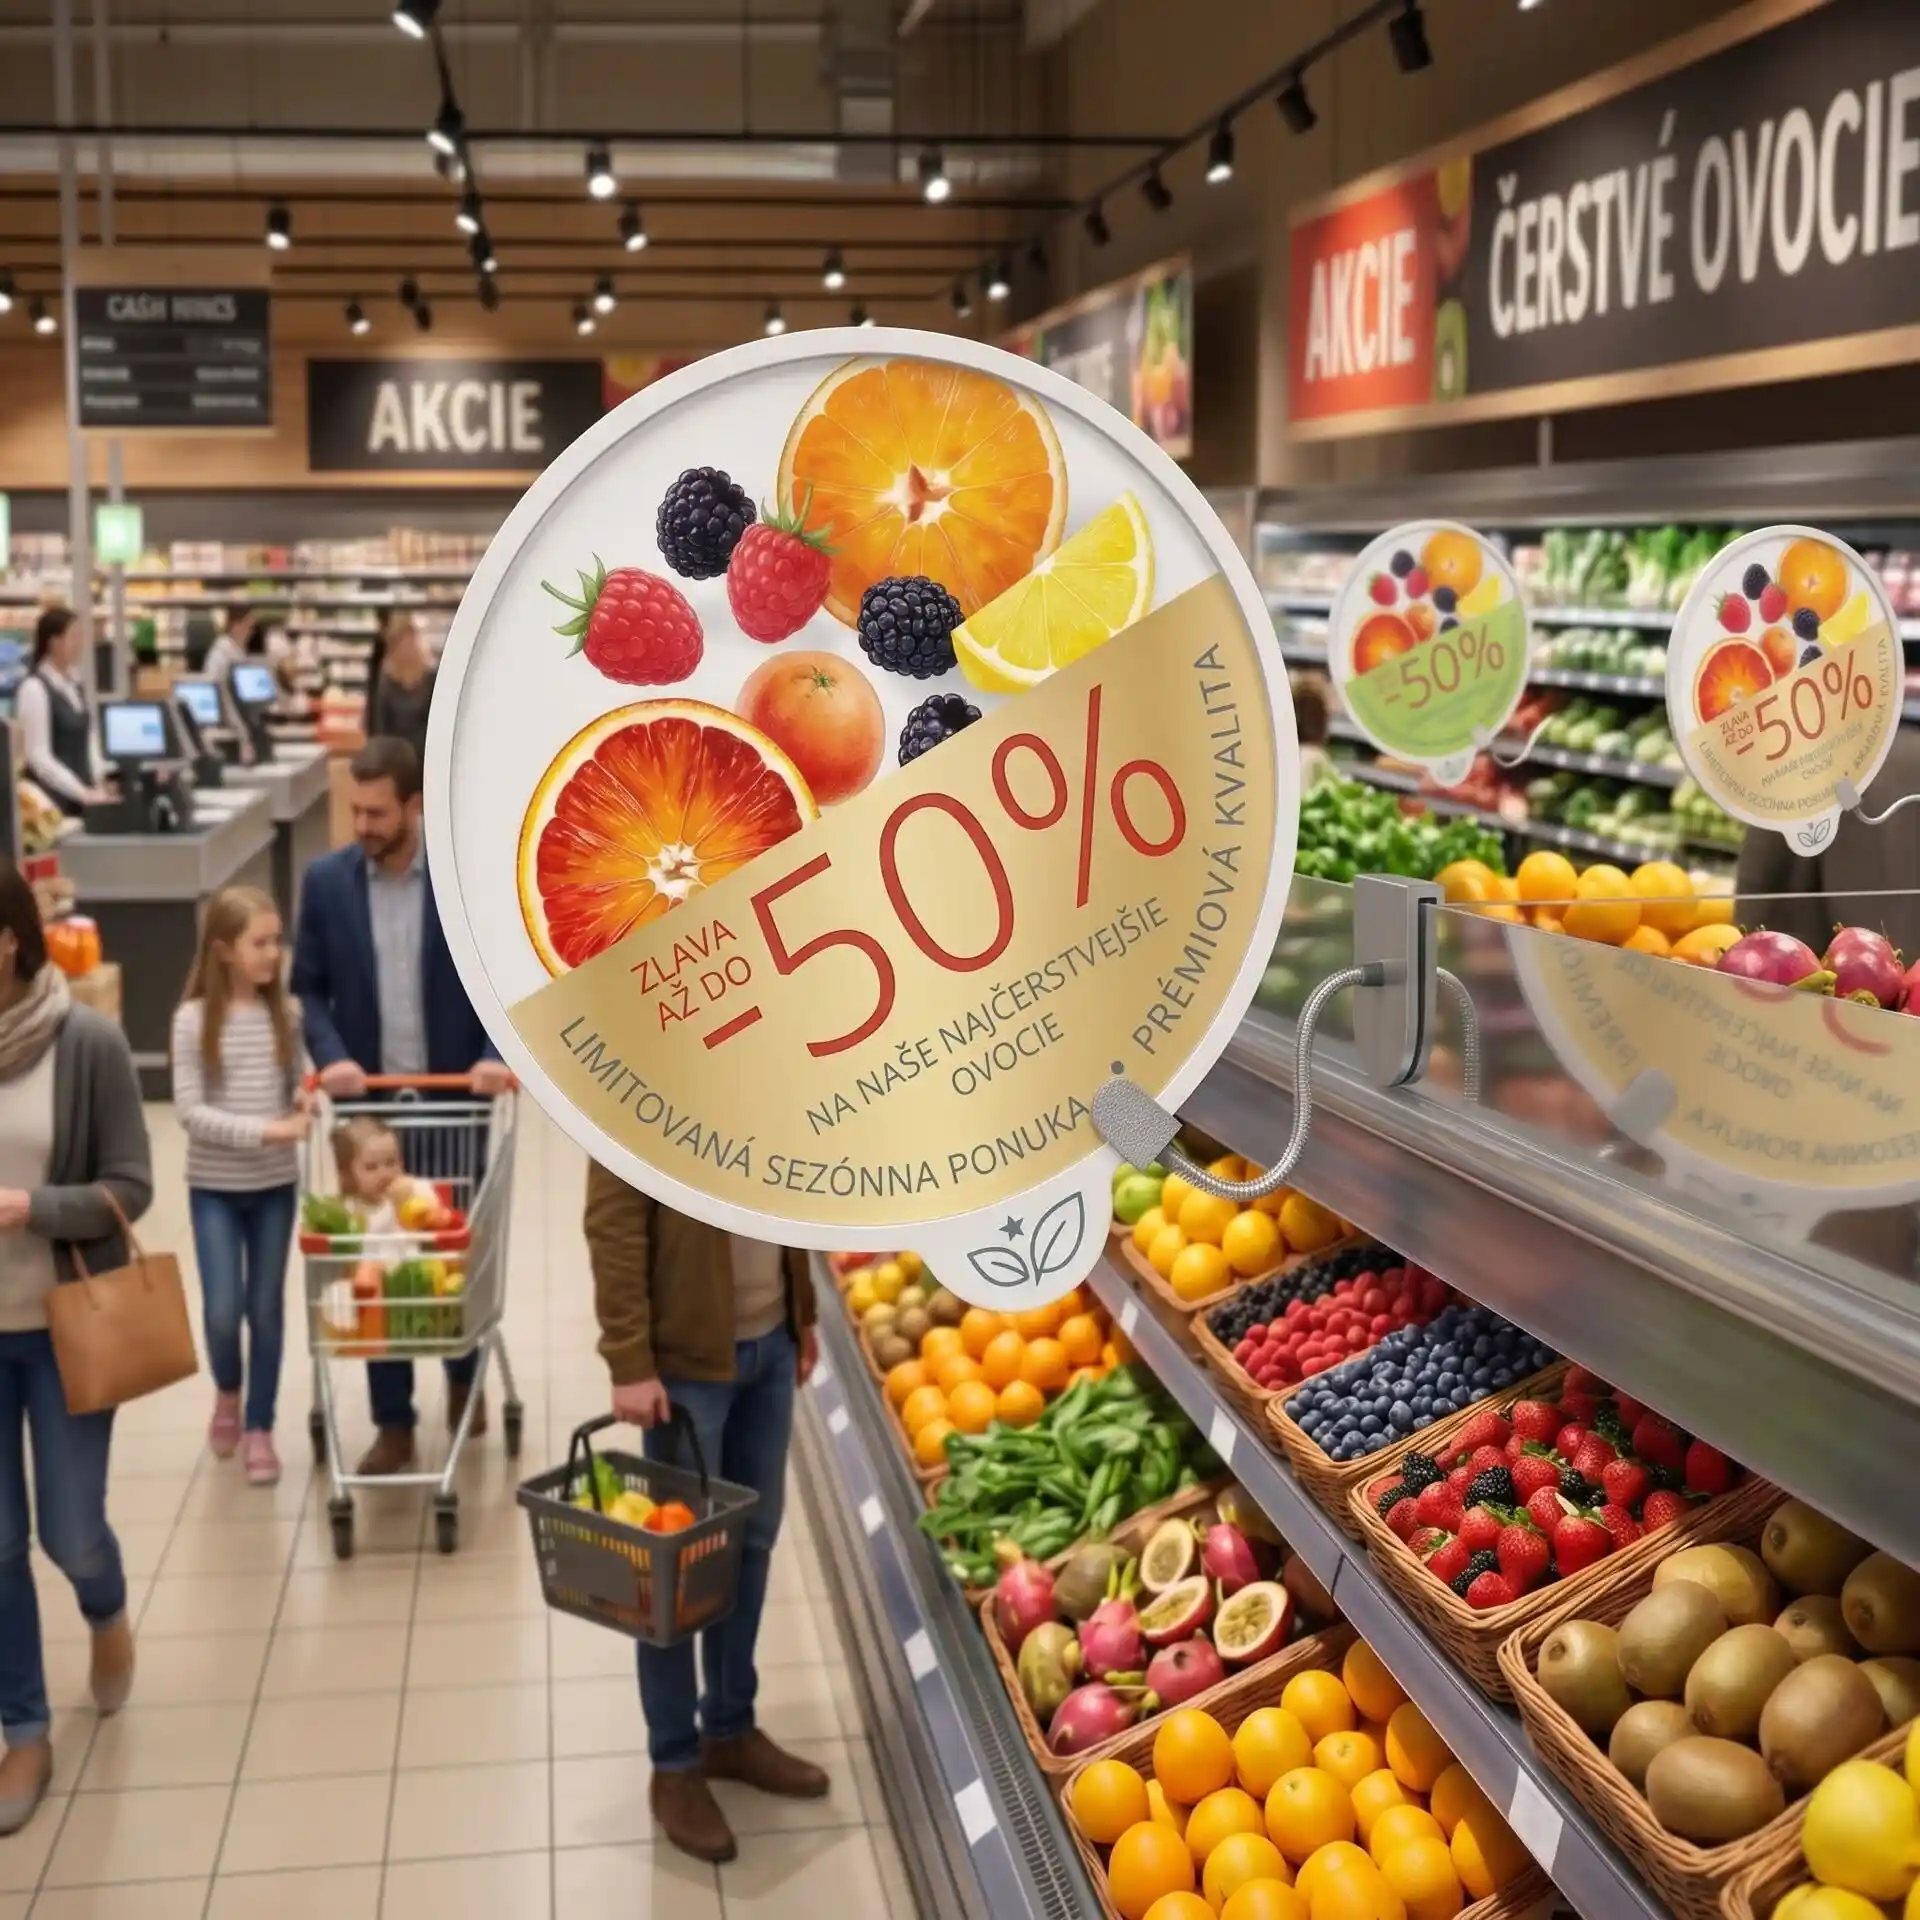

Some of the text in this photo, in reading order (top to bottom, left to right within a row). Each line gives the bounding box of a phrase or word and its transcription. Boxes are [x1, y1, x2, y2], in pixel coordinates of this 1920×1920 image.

[1489, 67, 1920, 338] ČERSTVÉ OVOCIE
[1305, 227, 1416, 383] AKCIE
[367, 378, 546, 454] AKCIE
[1736, 649, 1873, 761] -50%
[703, 683, 1187, 1057] -50%
[1132, 642, 1247, 1055] PRÉMIOVÁ KVALITA
[630, 919, 737, 996] ZLAVA
[658, 956, 751, 1033] AŽ DO
[806, 896, 1169, 1136] NA NAŠE NAJČERSTVEJŠIE
[559, 1015, 1090, 1198] LIMITOVANÁ SEZÓNNA PONUKA
[952, 1012, 1064, 1096] OVOCIE
